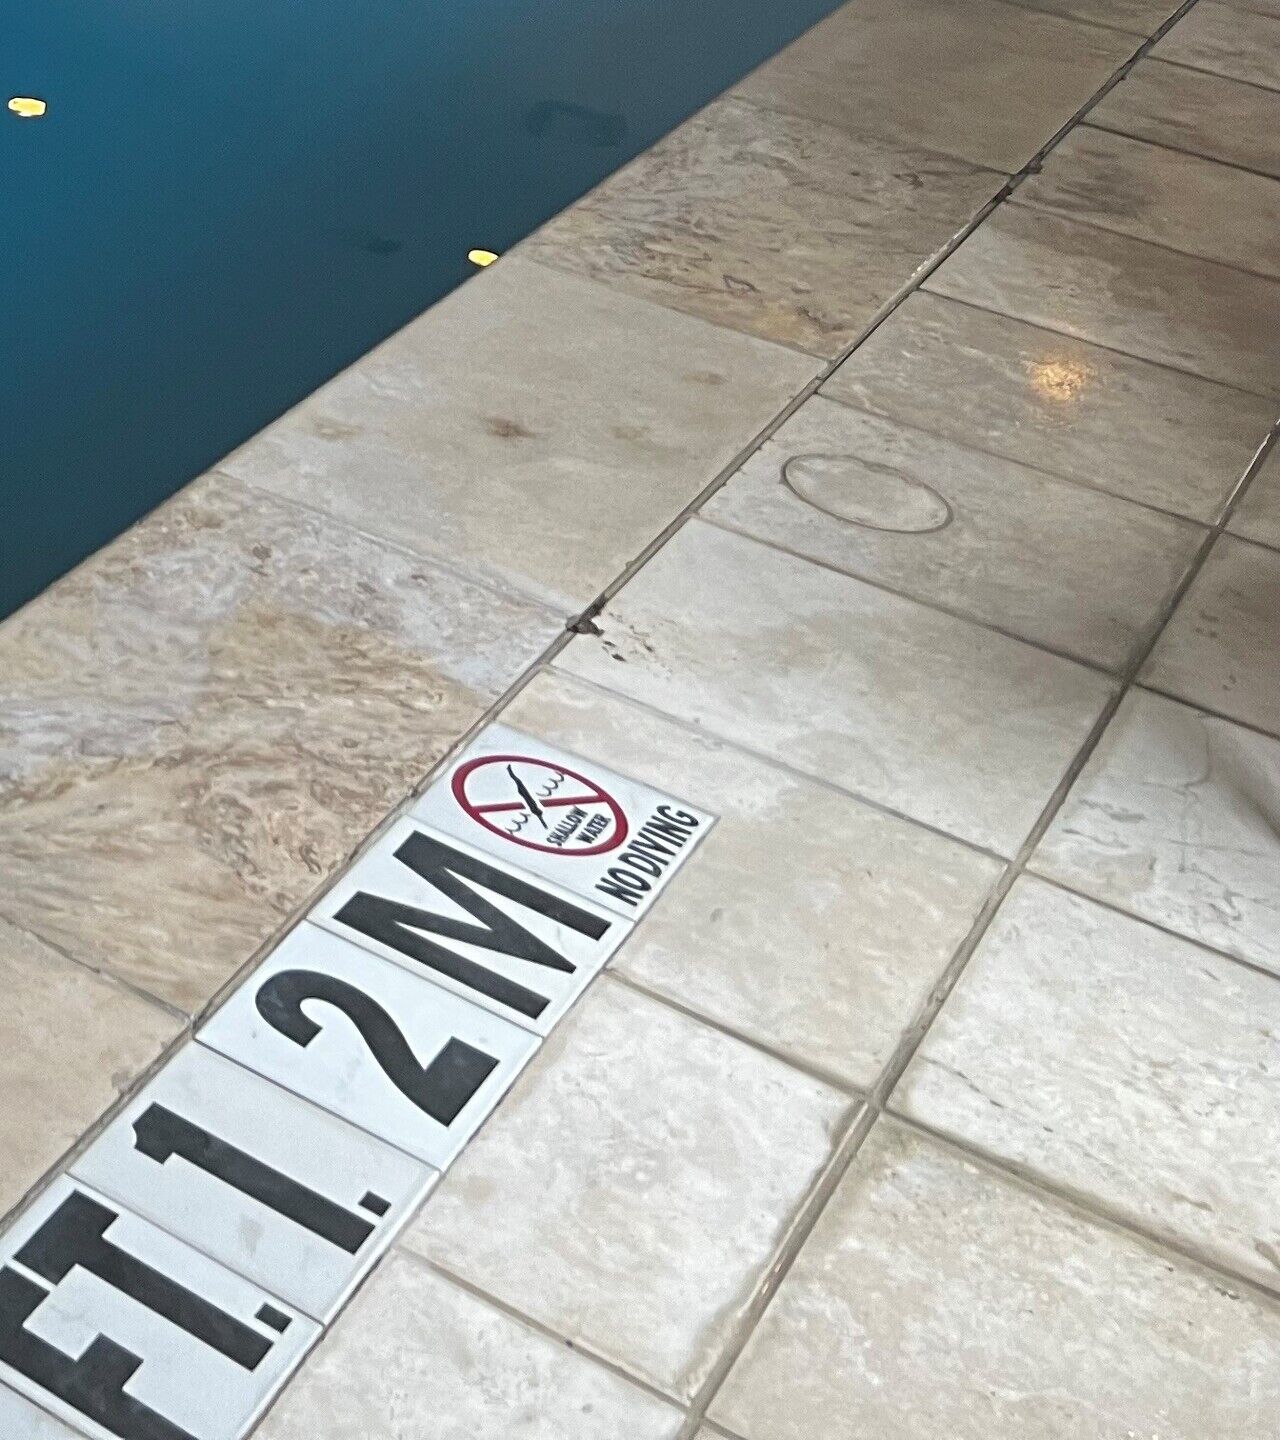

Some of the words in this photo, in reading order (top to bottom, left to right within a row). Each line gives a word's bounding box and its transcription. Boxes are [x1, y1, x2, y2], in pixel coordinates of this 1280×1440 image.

[547, 805, 588, 847] SHALLOW
[576, 814, 611, 844] WATER
[618, 805, 699, 879] DIVING
[595, 867, 651, 906] NO
[335, 830, 612, 1020] M
